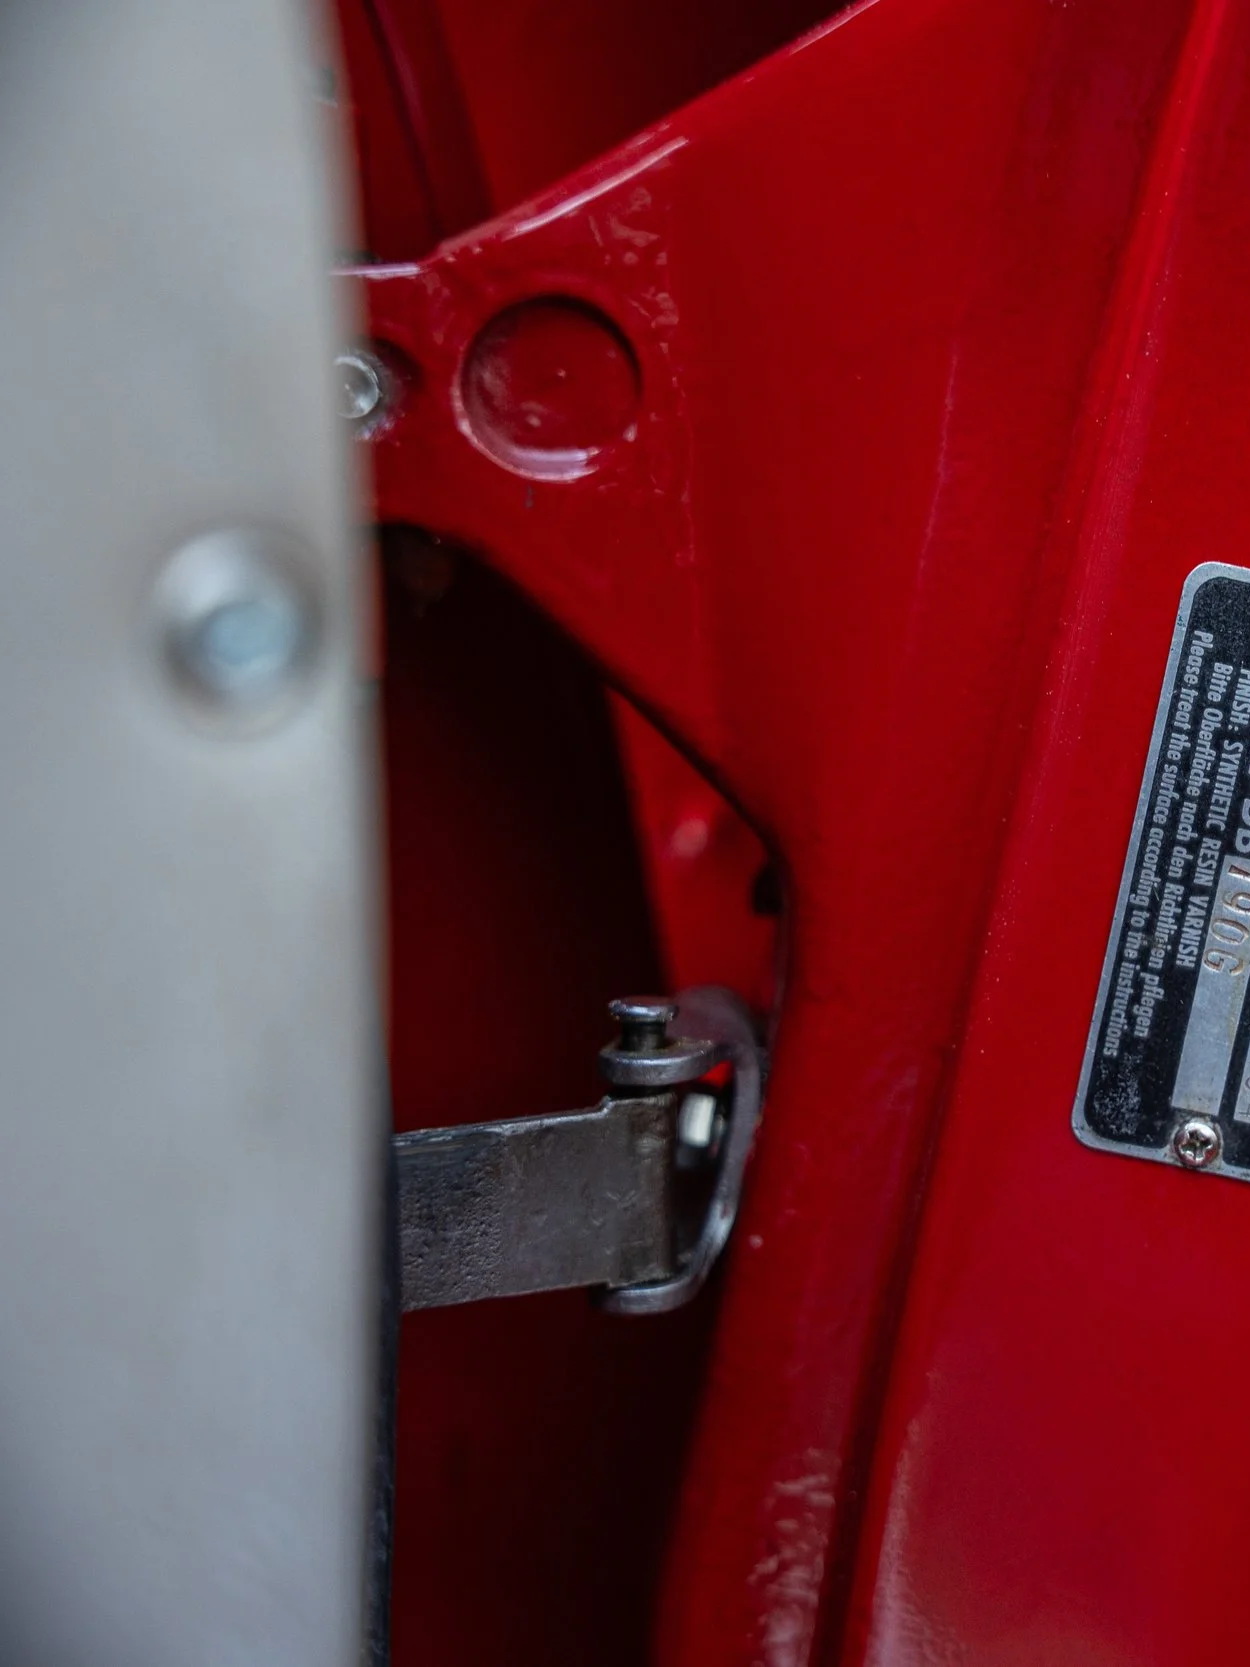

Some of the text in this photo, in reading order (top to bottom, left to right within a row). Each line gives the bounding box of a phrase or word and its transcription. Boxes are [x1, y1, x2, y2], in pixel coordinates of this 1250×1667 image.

[1182, 629, 1214, 686] Please
[1206, 662, 1233, 703] Bitte
[1172, 687, 1199, 730] treat
[1165, 733, 1191, 762] the
[1183, 706, 1224, 798] Oberfläche
[1150, 763, 1184, 826] surface
[1203, 738, 1244, 831] SYNTHETIC
[1174, 801, 1201, 843] nach
[1128, 826, 1170, 908] according
[1166, 845, 1194, 880] den
[1192, 836, 1222, 887] RESIN
[1129, 909, 1149, 928] to
[1173, 893, 1209, 968] VARNISH
[1099, 961, 1139, 1058] instructions
[1125, 972, 1166, 1039] pflegen
